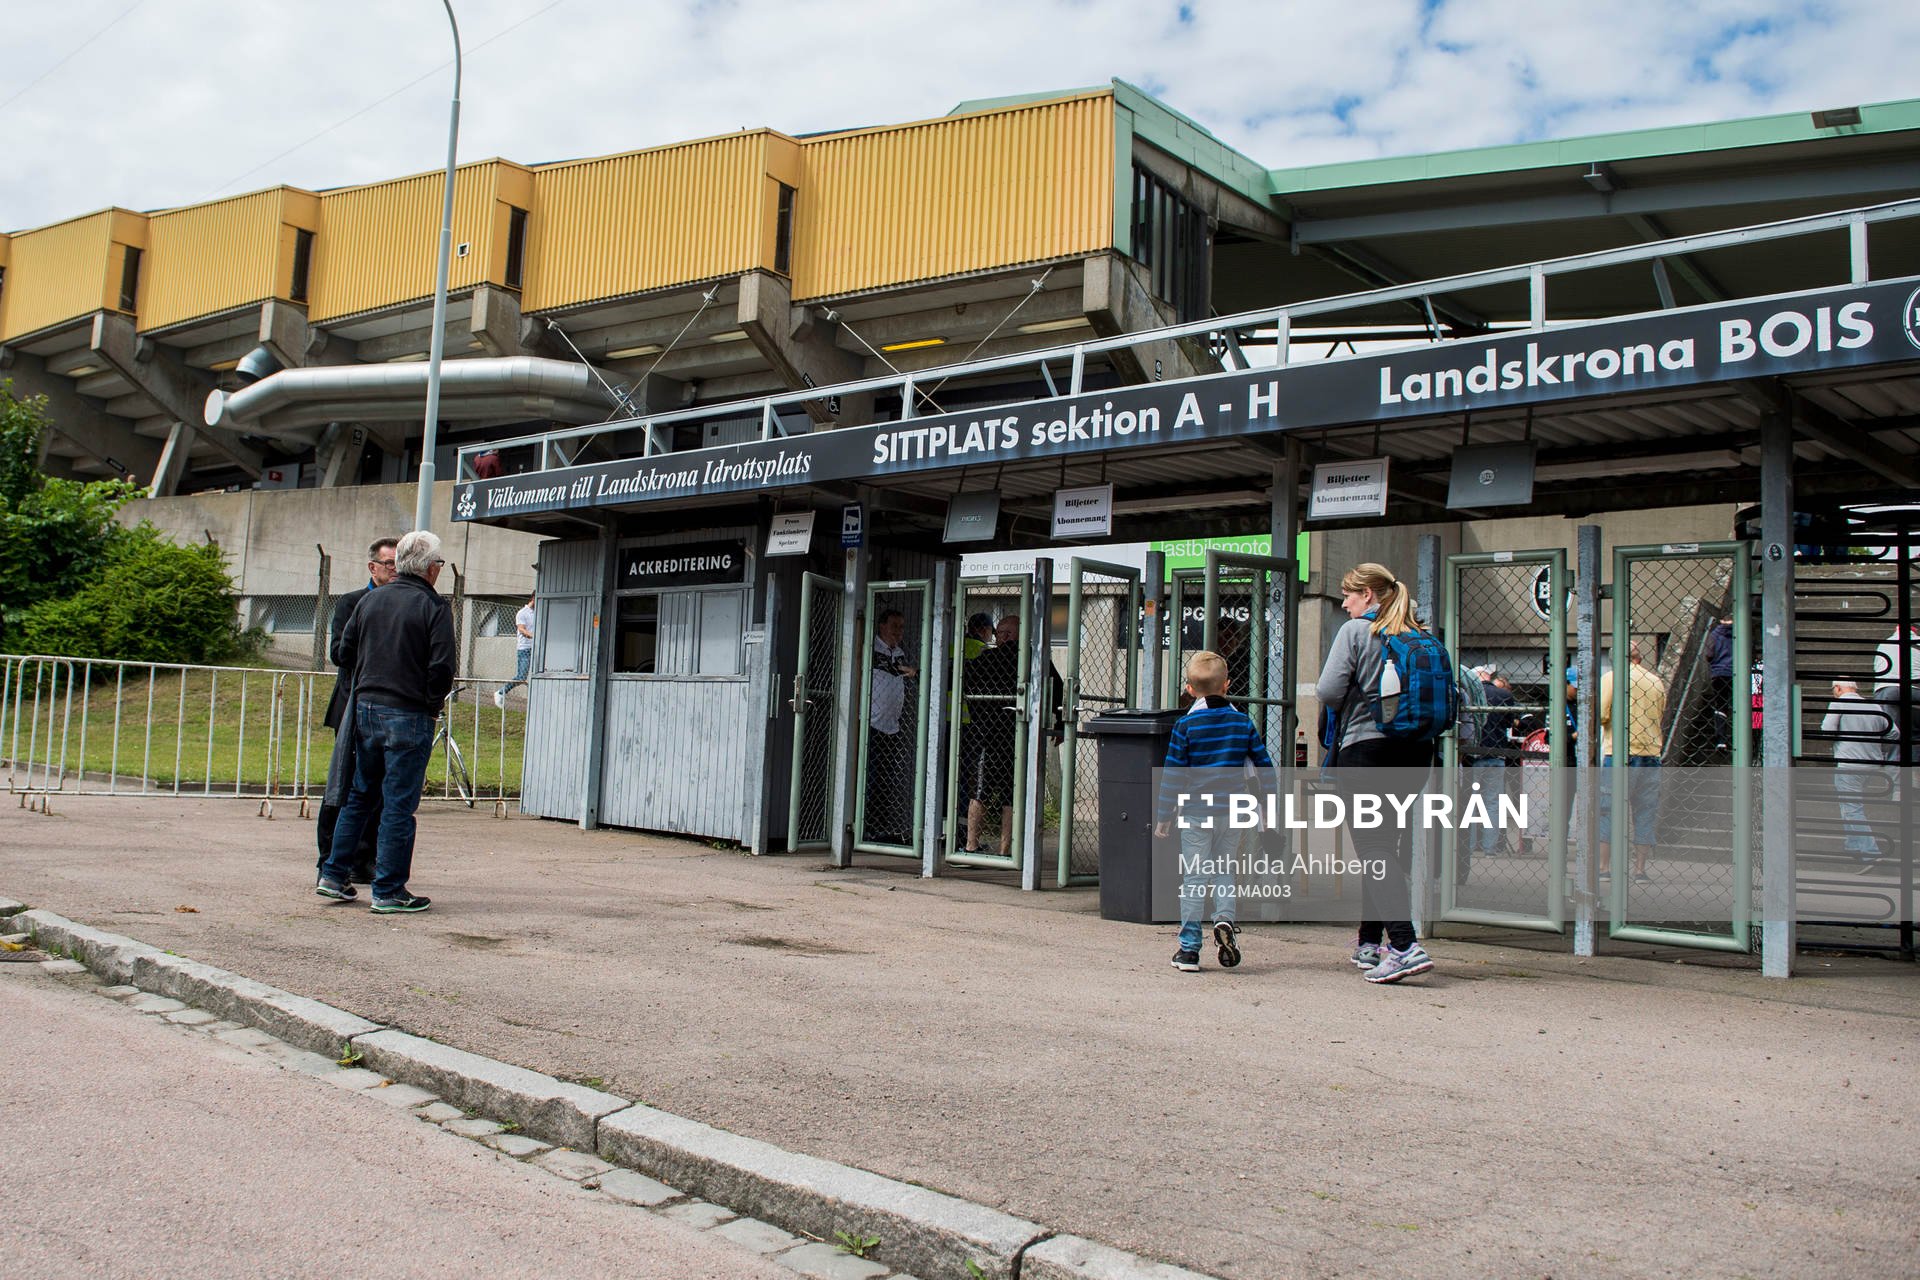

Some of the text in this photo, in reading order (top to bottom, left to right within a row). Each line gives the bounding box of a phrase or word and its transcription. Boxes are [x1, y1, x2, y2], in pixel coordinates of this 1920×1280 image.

[1379, 302, 1874, 404] Landskrona BOIS
[872, 416, 1019, 464] SITTPLATS
[1030, 402, 1160, 446] sektion
[1174, 393, 1204, 430] A
[1248, 381, 1279, 420] H
[487, 450, 812, 509] Välkommen till Landskrona Idrottsplats
[1326, 474, 1371, 485] Biljetter
[1064, 498, 1099, 508] Biljetter
[1056, 514, 1107, 525] Abonnemang
[1160, 538, 1271, 557] lastbilsmoto
[629, 554, 732, 576] ACKREDITERING
[970, 562, 988, 571] one
[992, 561, 1000, 571] in
